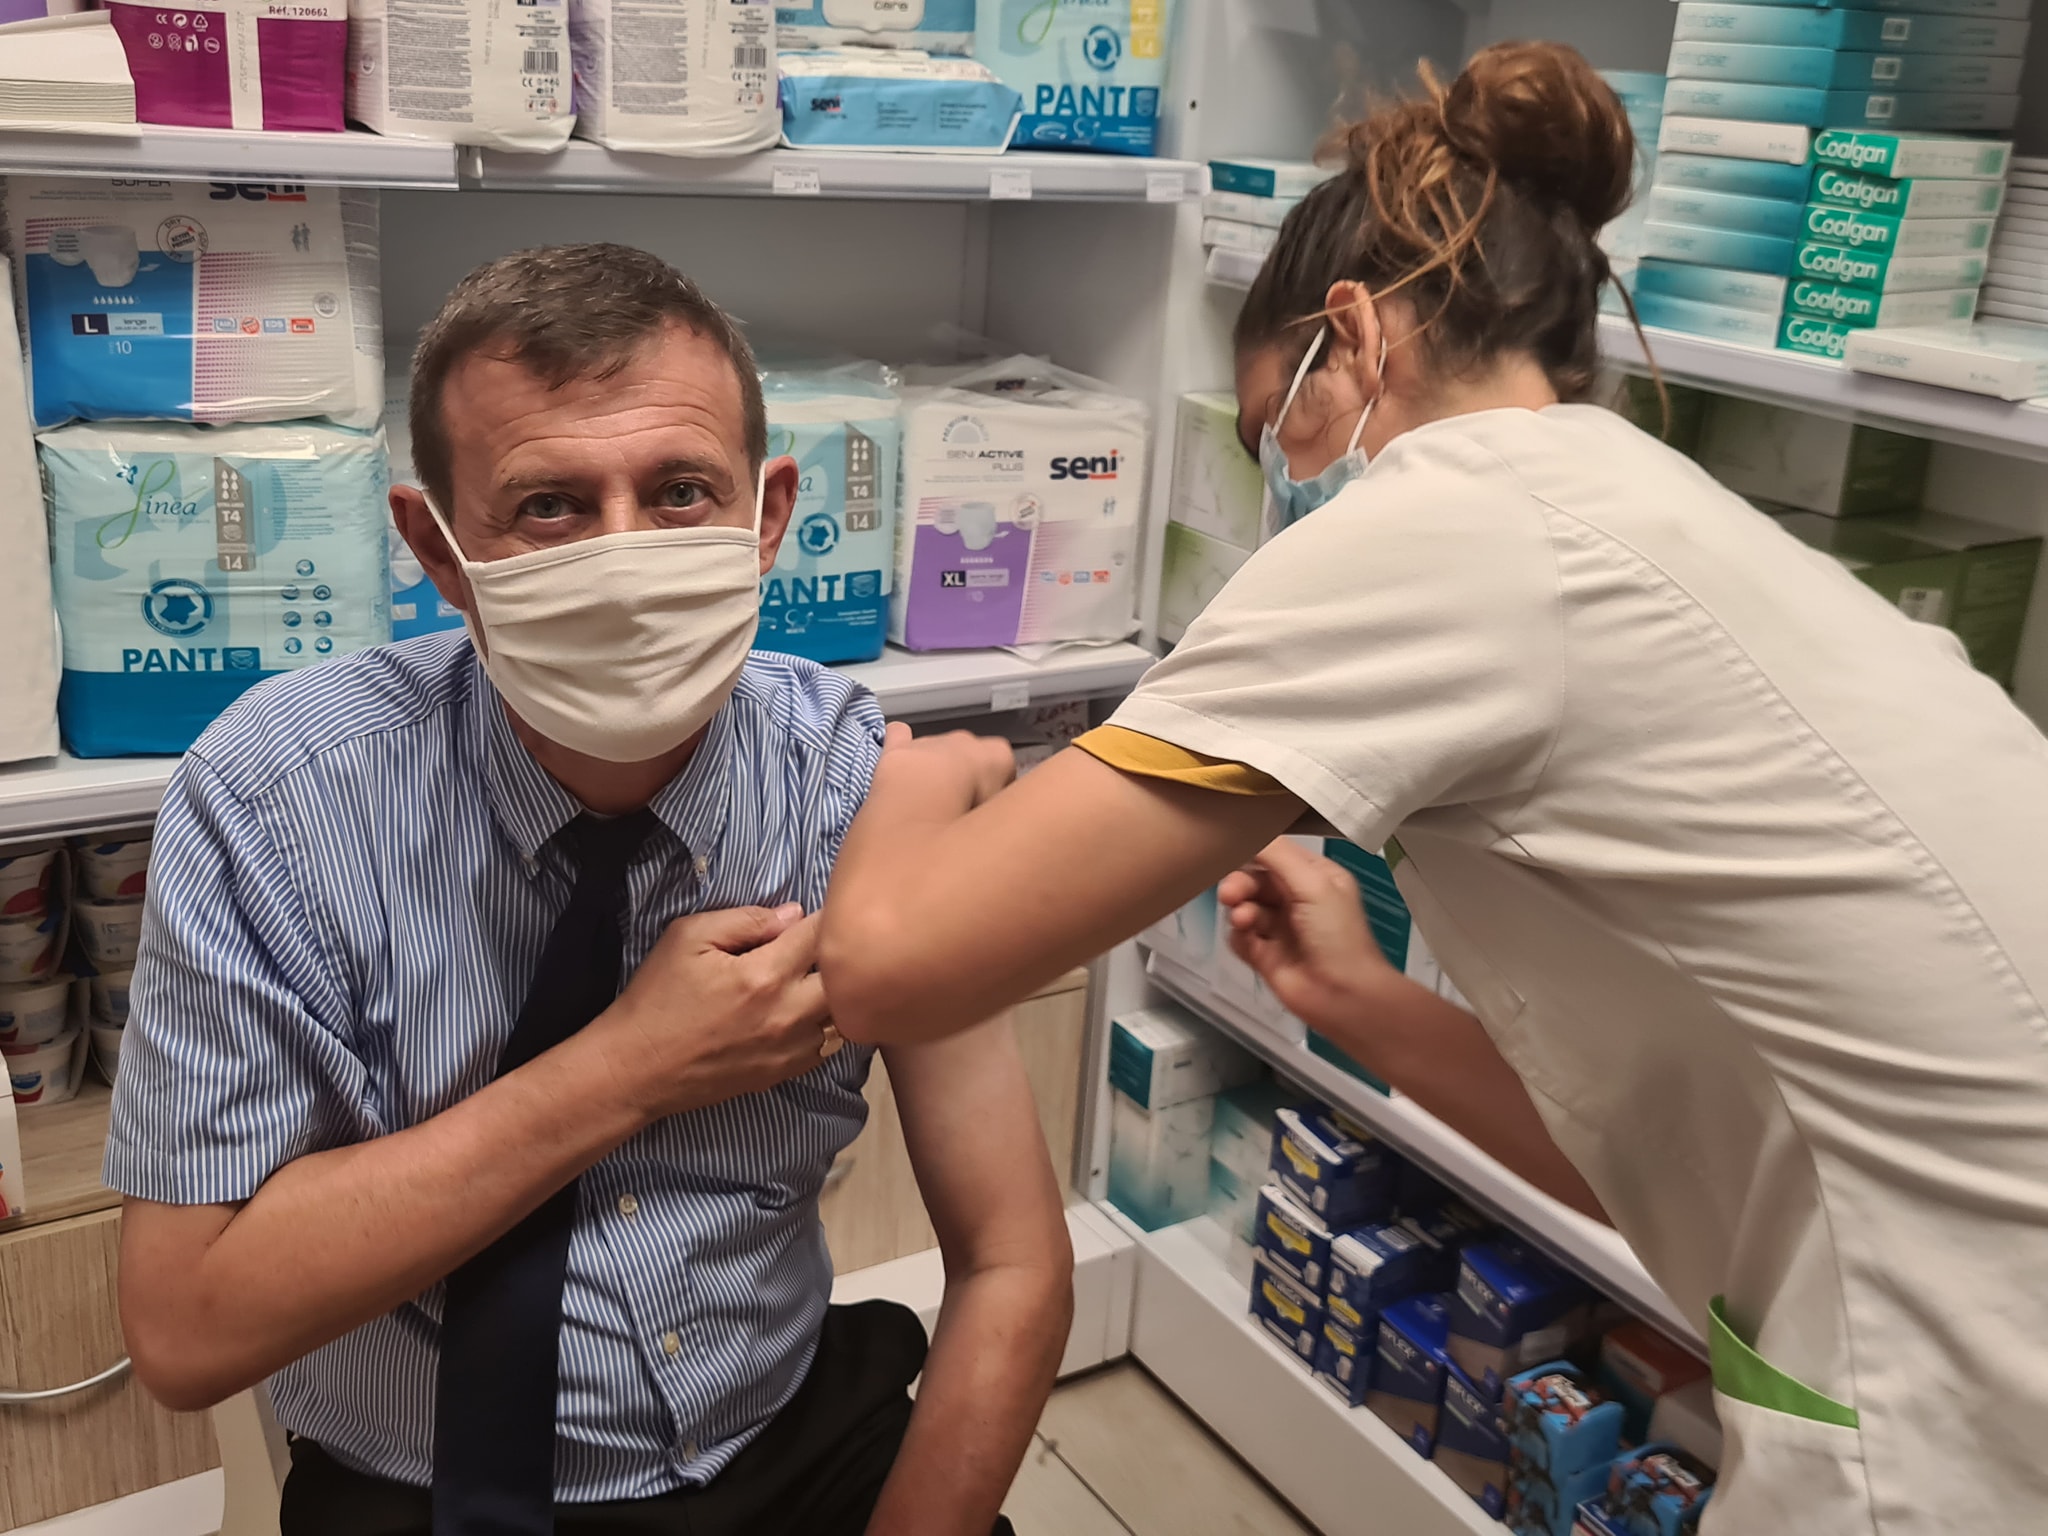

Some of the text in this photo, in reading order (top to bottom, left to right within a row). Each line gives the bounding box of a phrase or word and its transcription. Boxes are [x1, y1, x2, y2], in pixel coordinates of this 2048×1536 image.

[1036, 84, 1126, 117] PANT
[1814, 132, 1888, 168] Coalgan
[1818, 170, 1898, 208] Coalgan
[1808, 208, 1888, 246] Coalgan
[1799, 245, 1878, 282] Coalgan
[1793, 282, 1872, 319] Coalgan
[84, 316, 99, 333] L
[1786, 319, 1847, 356] Coalg
[115, 340, 132, 354] 10
[979, 450, 1024, 459] ACTIVE
[1050, 449, 1116, 480] seni
[221, 510, 242, 523] T4
[852, 514, 869, 530] 14
[224, 555, 243, 570] 14
[759, 575, 841, 606] ANT
[943, 573, 964, 586] XL
[122, 648, 217, 672] PANT
